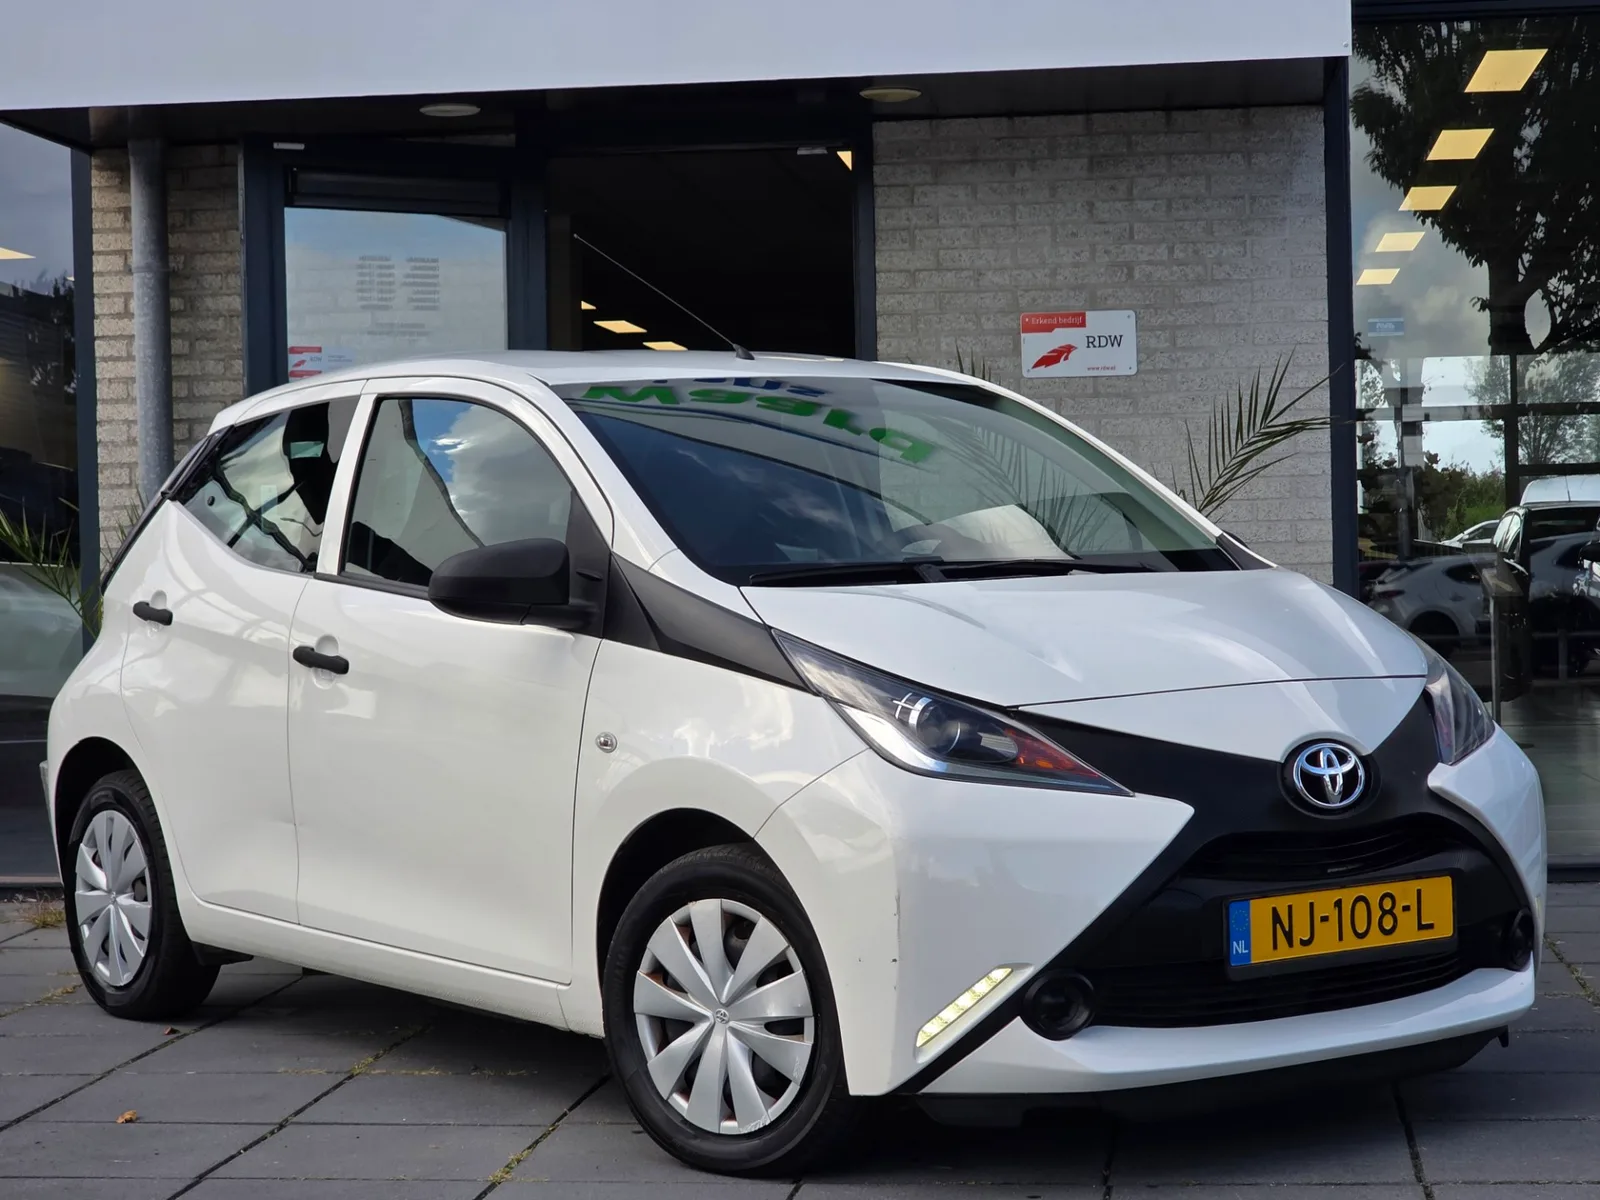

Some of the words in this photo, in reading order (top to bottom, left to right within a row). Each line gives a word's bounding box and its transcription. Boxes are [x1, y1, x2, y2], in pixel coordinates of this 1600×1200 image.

[1031, 316, 1057, 325] Erkend
[1058, 316, 1083, 326] bedrijf
[1085, 334, 1123, 349] RDW
[1271, 888, 1435, 951] NJ-108-L
[1232, 940, 1249, 955] NL
